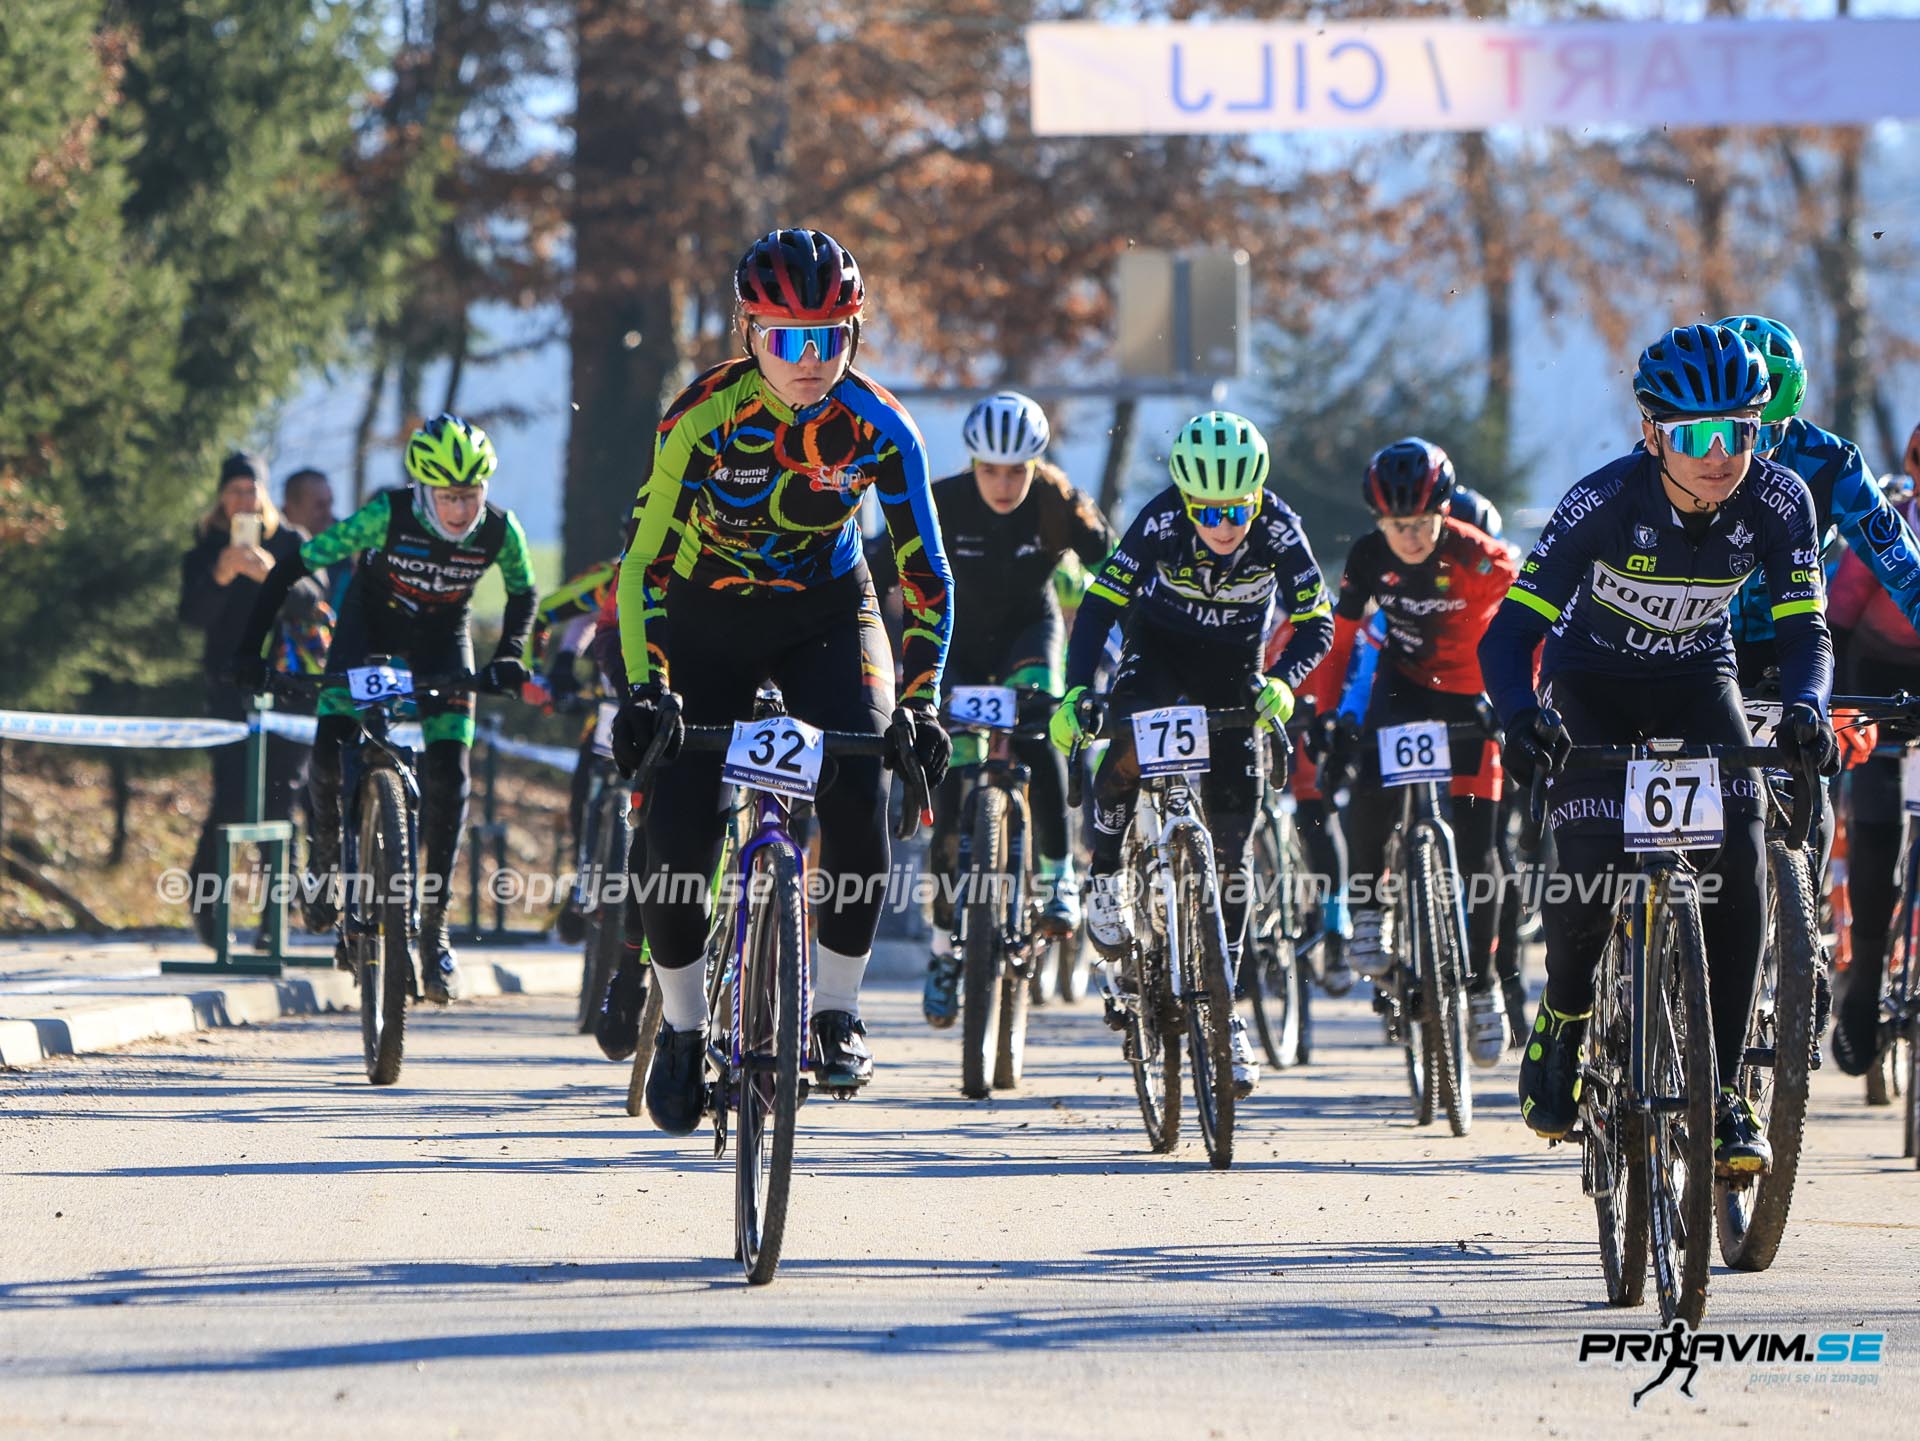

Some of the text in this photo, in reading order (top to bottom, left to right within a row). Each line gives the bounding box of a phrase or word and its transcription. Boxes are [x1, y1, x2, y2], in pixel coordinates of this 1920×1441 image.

[1557, 485, 1590, 516] FEEL
[1770, 473, 1804, 504] FEEL
[1595, 571, 1678, 622] POGI
[1625, 626, 1699, 655] UAE
[967, 697, 1002, 722] 33
[748, 729, 806, 775] 32
[1150, 718, 1196, 758] 75
[1396, 734, 1434, 767] 68
[1551, 798, 1624, 831] ENERALI
[1645, 777, 1700, 828] 67
